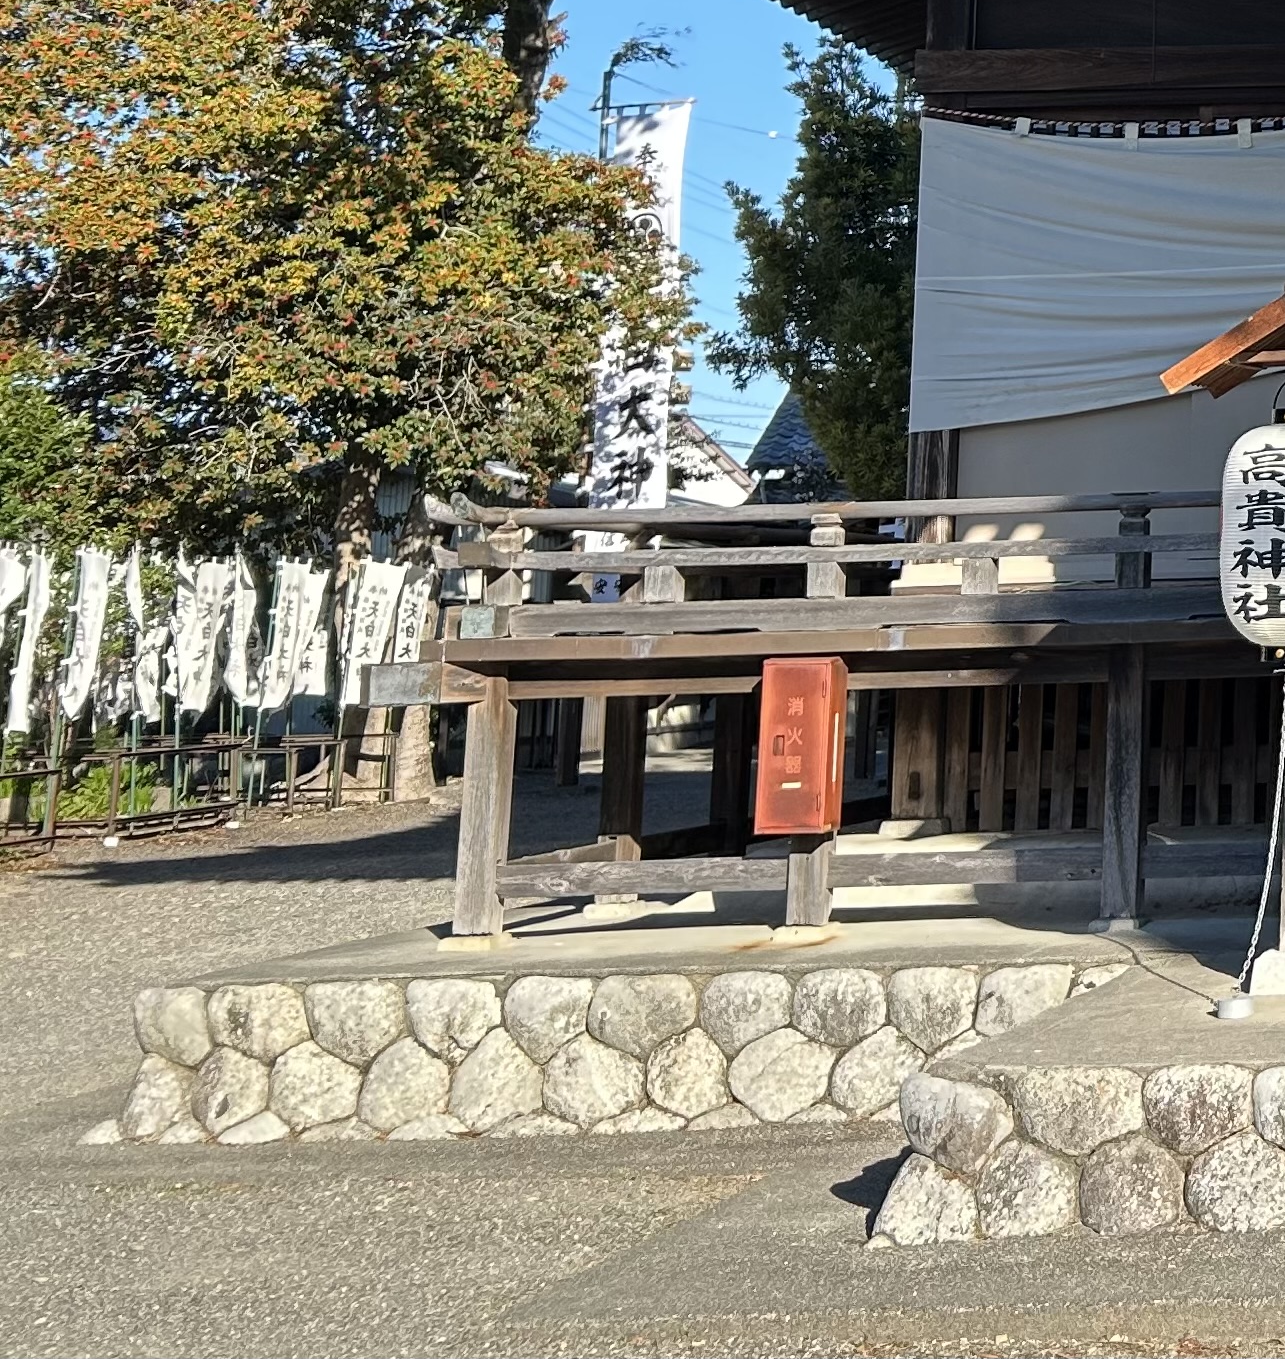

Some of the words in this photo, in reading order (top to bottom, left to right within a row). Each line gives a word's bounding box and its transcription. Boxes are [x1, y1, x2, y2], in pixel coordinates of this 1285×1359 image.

[607, 350, 660, 500] 大神
[785, 696, 805, 774] 消火器
